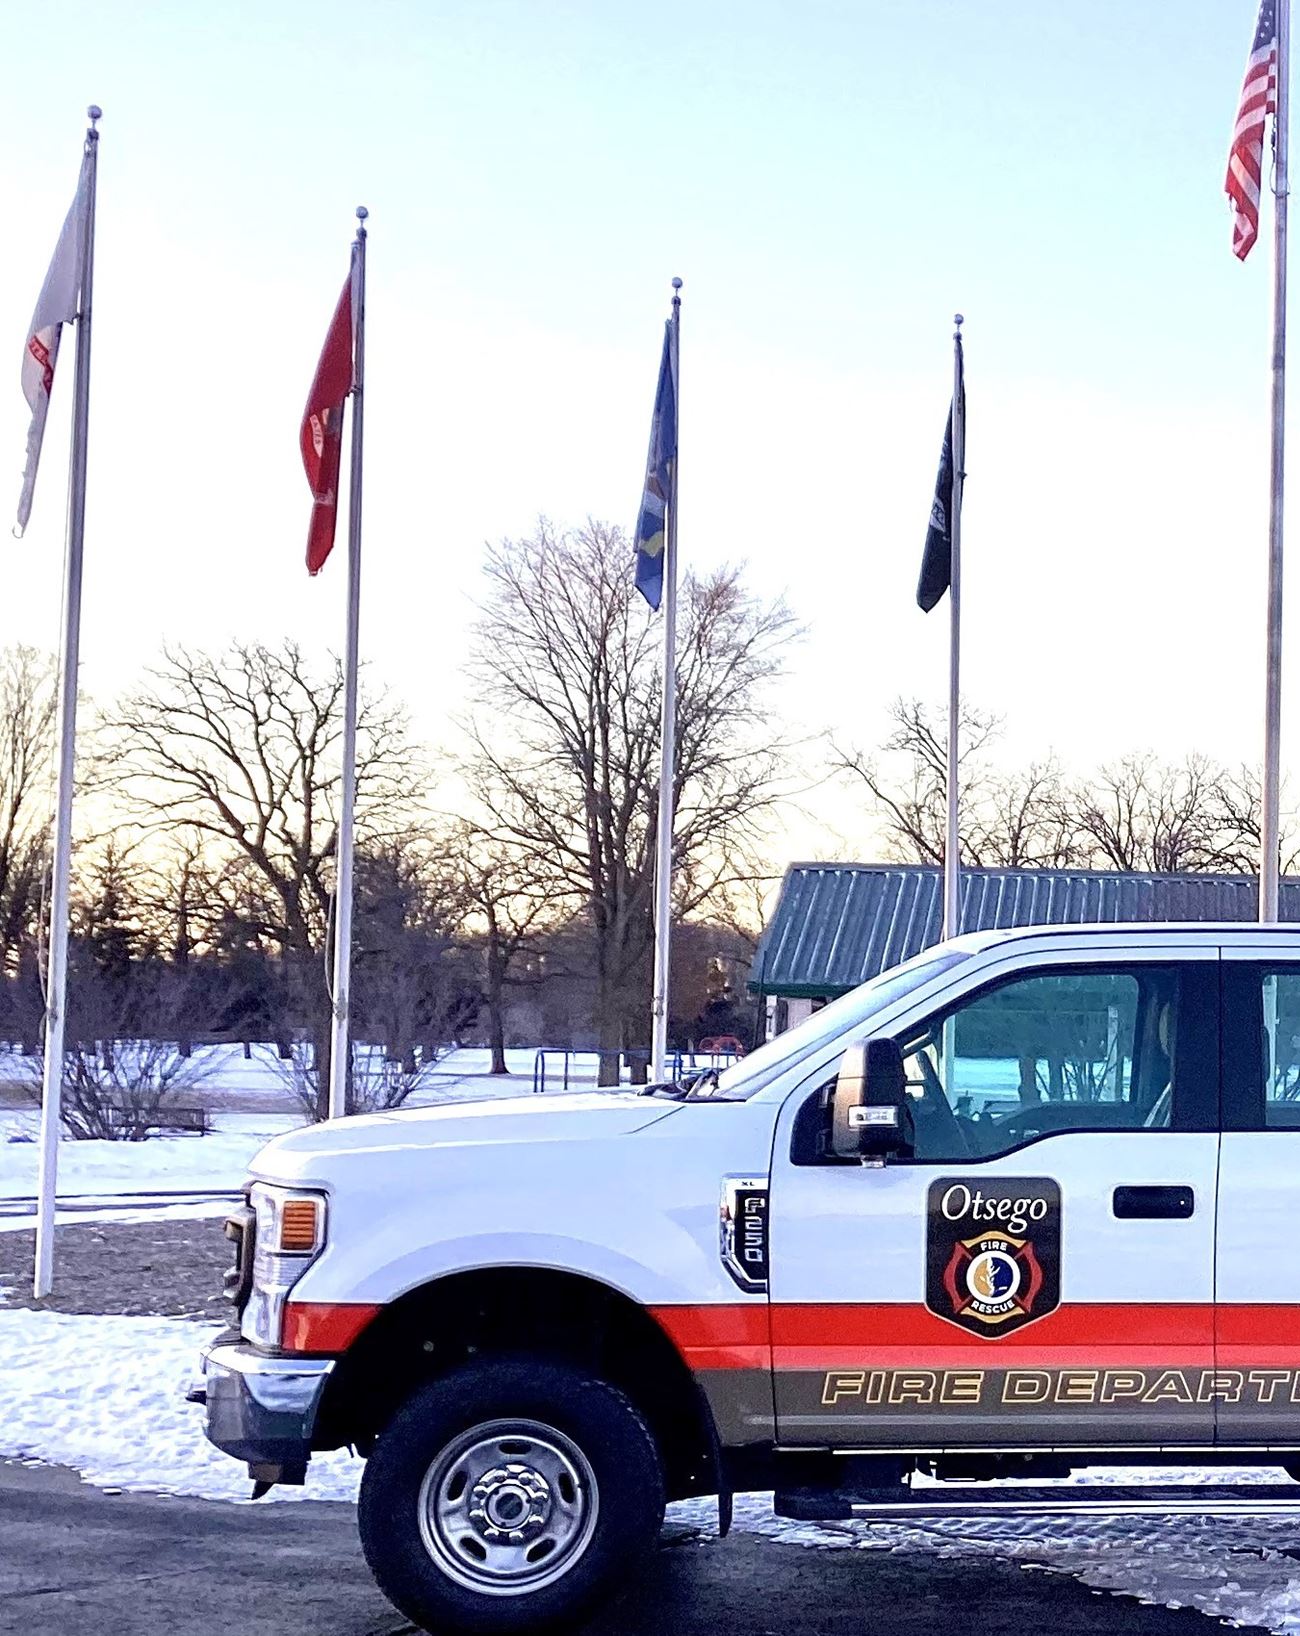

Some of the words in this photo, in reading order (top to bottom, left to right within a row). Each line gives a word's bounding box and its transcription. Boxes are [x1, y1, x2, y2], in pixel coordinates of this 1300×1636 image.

[941, 1183, 1048, 1234] Otsego
[980, 1240, 1008, 1251] FIRE
[970, 1299, 1016, 1314] RESCUE
[821, 1370, 985, 1404] FIRE
